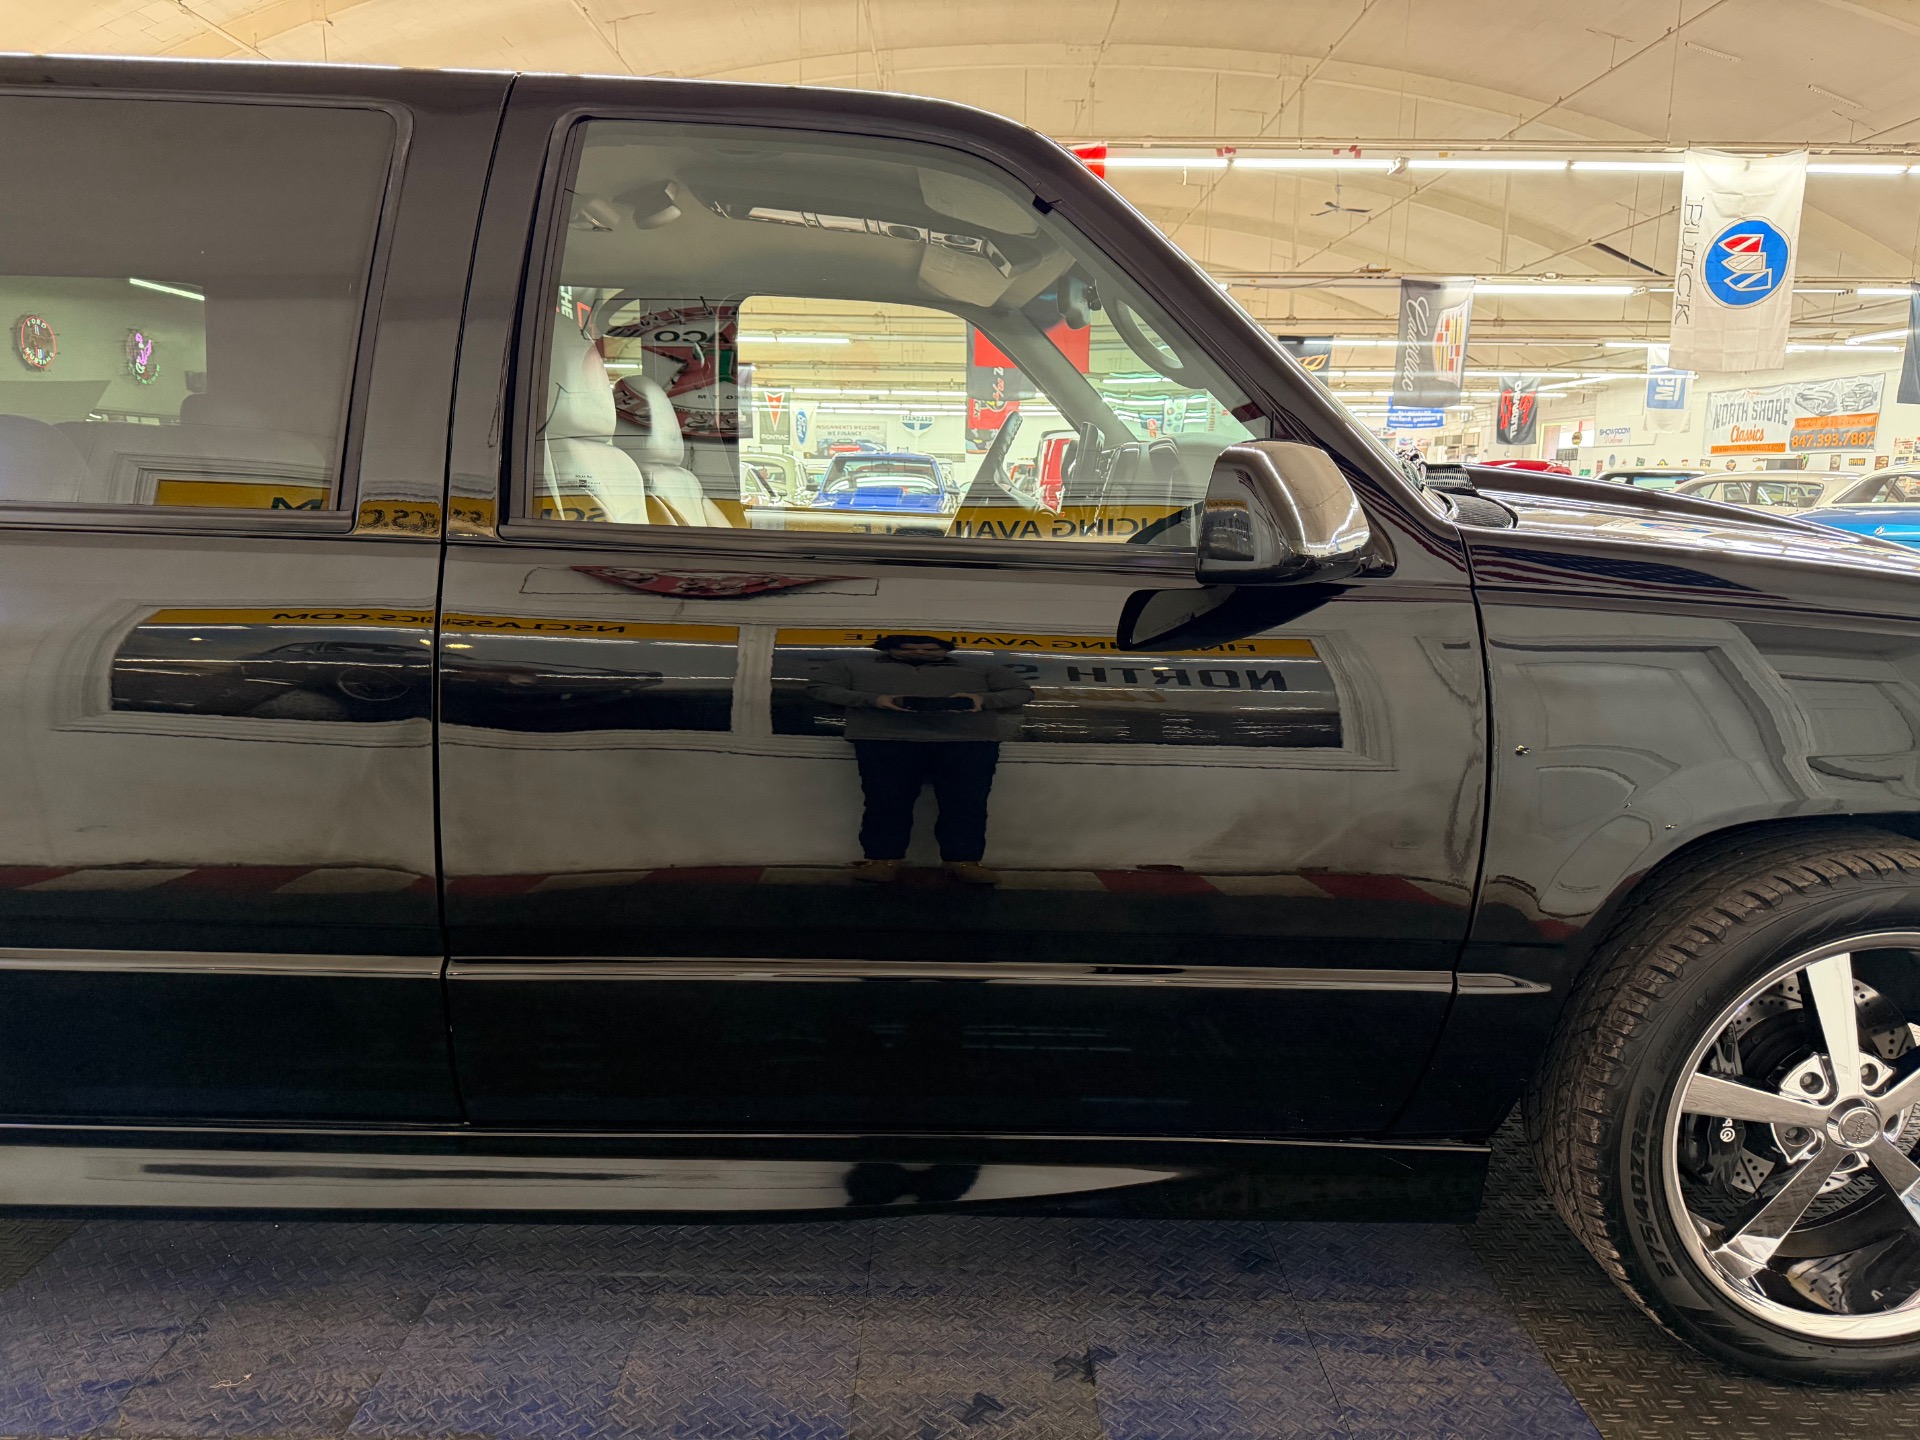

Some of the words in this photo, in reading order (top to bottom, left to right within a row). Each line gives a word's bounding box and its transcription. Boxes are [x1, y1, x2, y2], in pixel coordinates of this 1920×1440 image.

[1675, 197, 1703, 325] BUICK
[1402, 296, 1430, 392] Cadillac
[795, 414, 807, 438] Ford
[1712, 402, 1749, 430] NORTH
[1751, 398, 1790, 426] SHORE
[761, 433, 789, 441] PONTIAC
[1730, 424, 1765, 443] Classics
[1791, 431, 1877, 448] 847.393.7887
